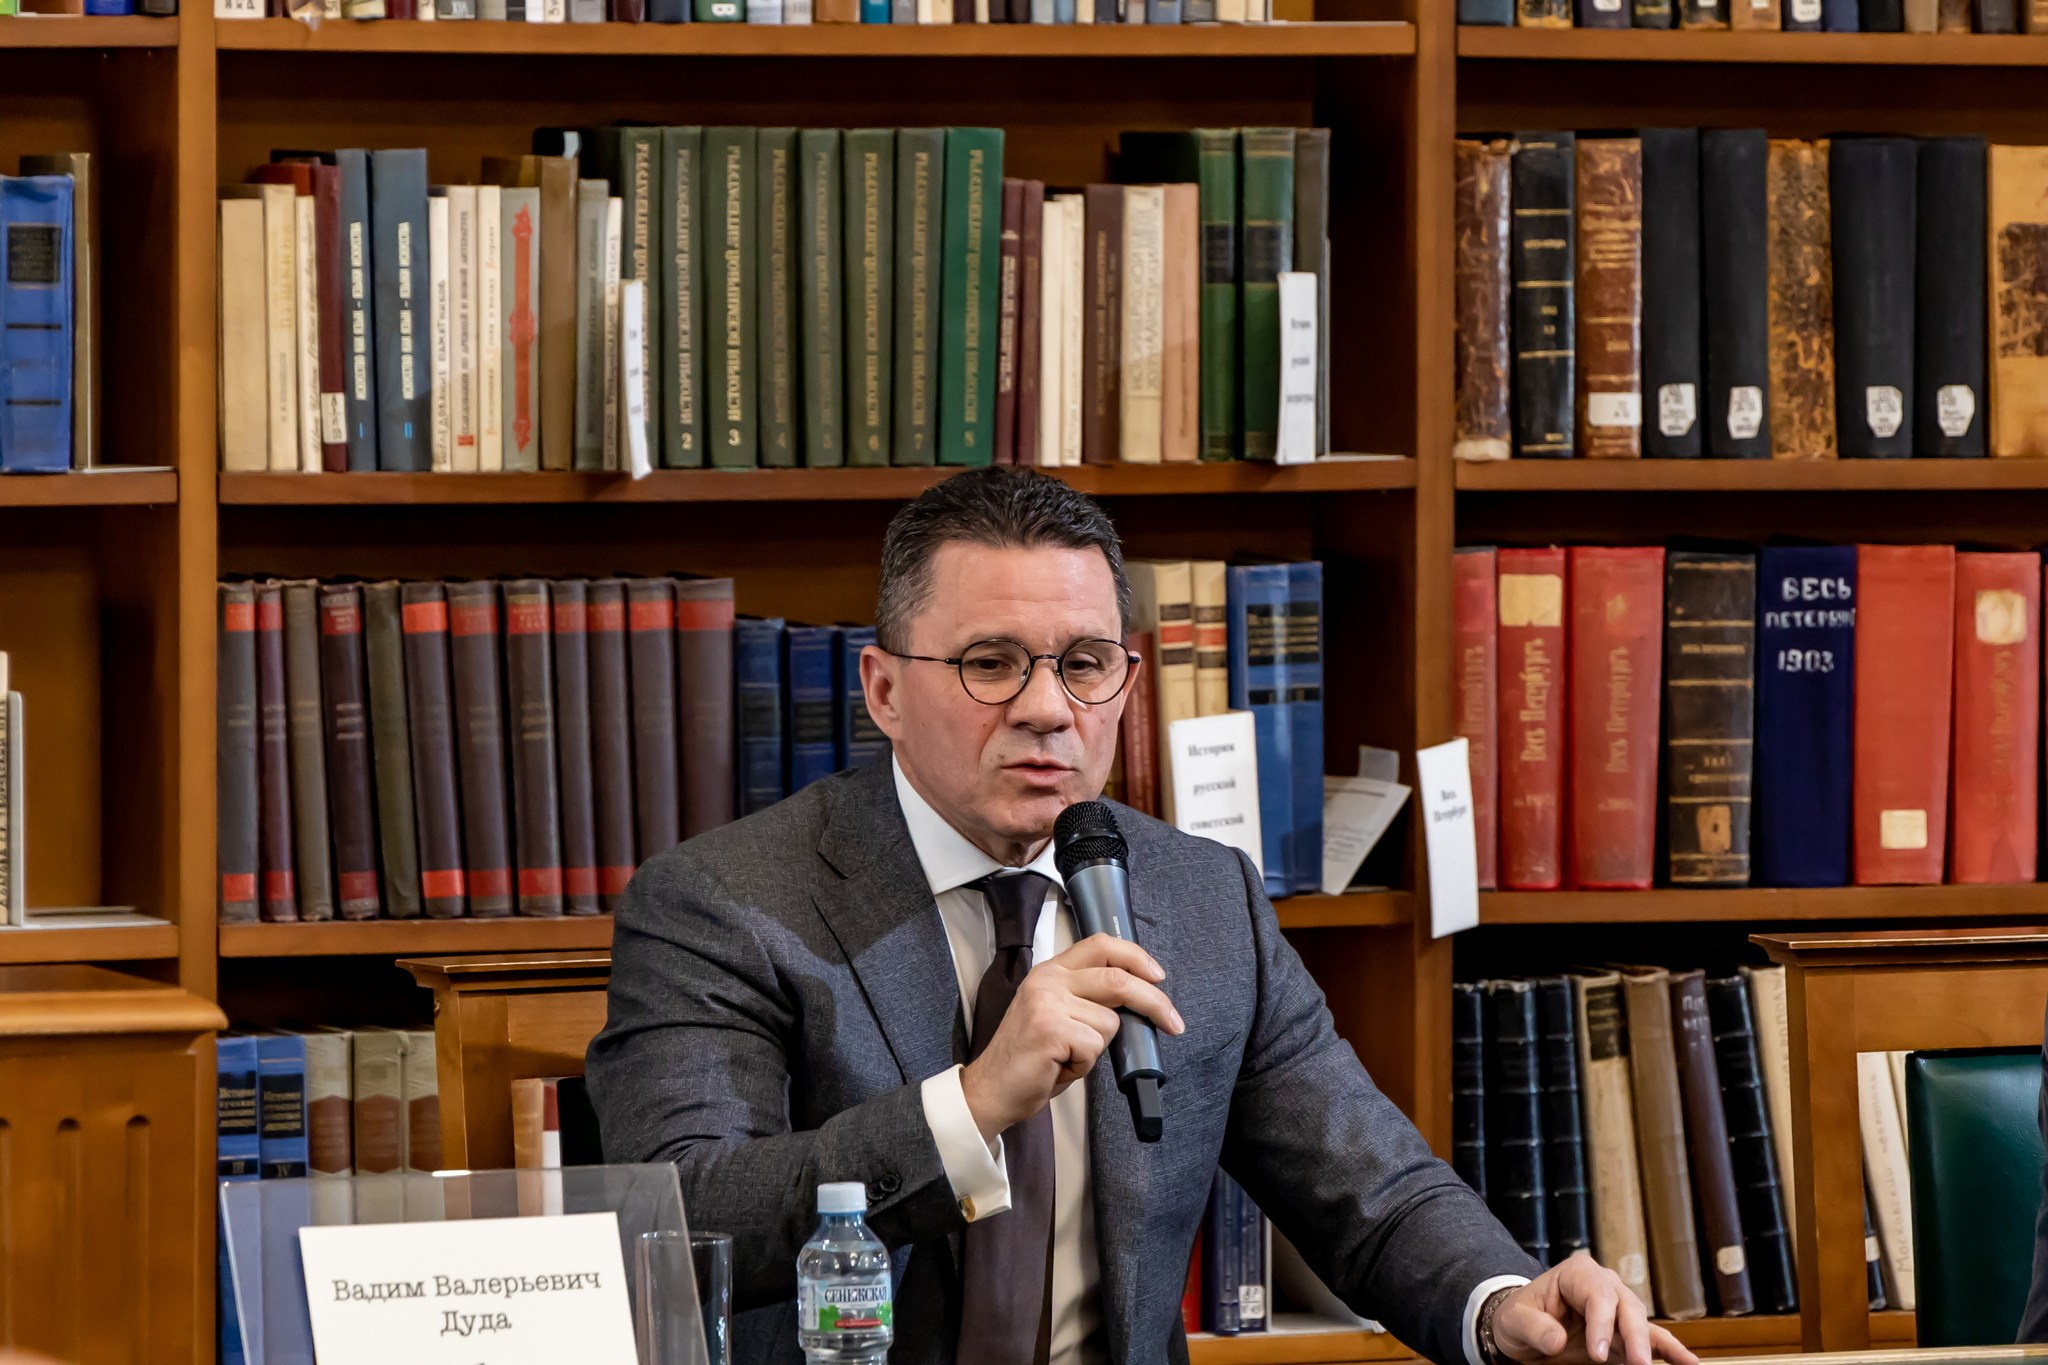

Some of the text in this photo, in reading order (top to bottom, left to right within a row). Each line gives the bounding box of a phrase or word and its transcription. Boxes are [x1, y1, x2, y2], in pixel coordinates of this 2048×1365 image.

[725, 146, 740, 445] 3 ИСТОРИЯ ВСЕМИРНОЙ ЛИТЕРАТУРЫ
[681, 433, 693, 450] 2
[1782, 577, 1851, 601] ВЕСЬ
[1778, 649, 1834, 672] 1903
[1188, 742, 1235, 757] История
[1193, 778, 1236, 796] русской
[1190, 814, 1245, 830] советской
[332, 1271, 602, 1304] Вадим Валерьевич
[825, 1285, 887, 1303] СЕНЕЖСКАЯ
[440, 1311, 512, 1337] Дуда
